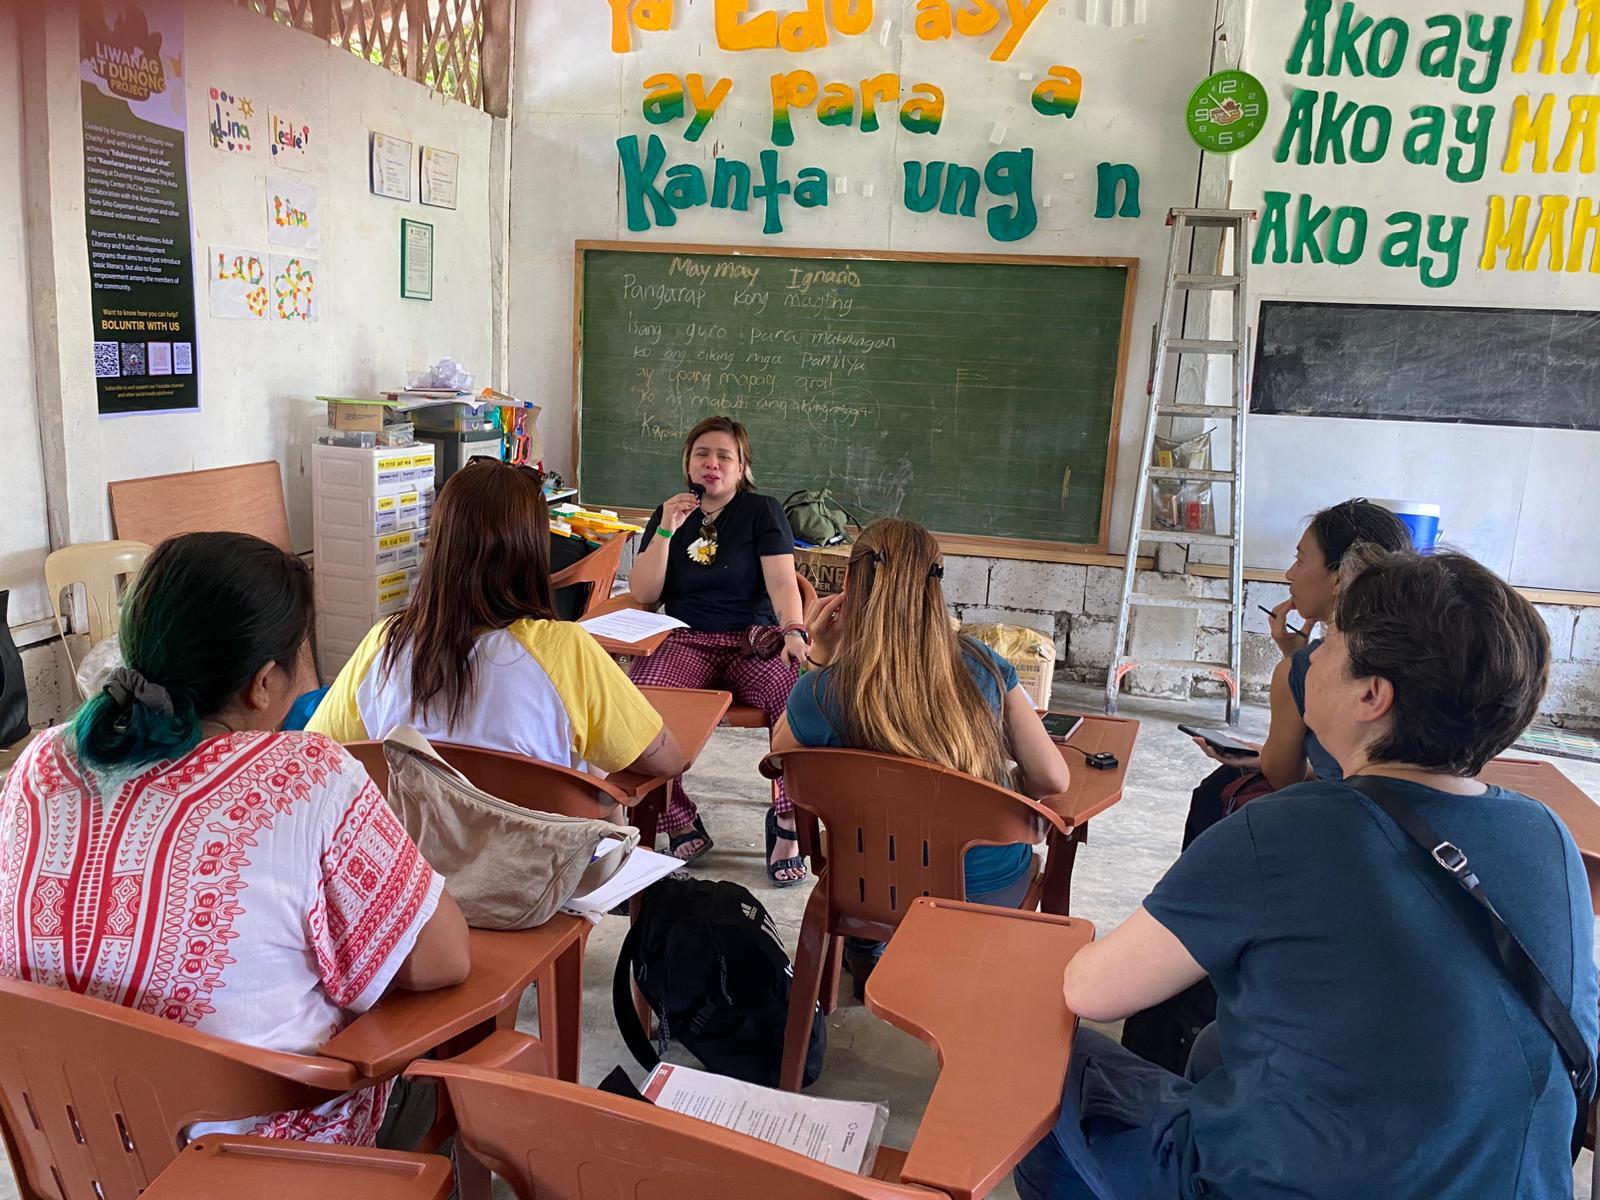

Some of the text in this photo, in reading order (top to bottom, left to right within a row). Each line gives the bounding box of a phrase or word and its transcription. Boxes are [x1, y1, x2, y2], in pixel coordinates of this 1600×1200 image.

[96, 41, 159, 75] LIWANAG
[1286, 0, 1409, 78] Ako
[1419, 14, 1512, 94] ay
[91, 56, 165, 91] AT DUNONG
[110, 79, 148, 98] PROJECT
[1219, 80, 1236, 94] 12
[642, 65, 1083, 147] ay para a
[1195, 109, 1209, 122] 9
[1244, 104, 1259, 117] 3
[1218, 131, 1233, 145] 6
[1274, 89, 1392, 166] Ako
[1403, 105, 1496, 183] ay
[616, 134, 1141, 242] Kanta ung n
[1251, 191, 1600, 288] Ako ay MAH
[102, 308, 116, 316] Want
[123, 309, 136, 317] know
[137, 309, 147, 317] how
[101, 320, 180, 332] BOLUNTIR WITH US
[686, 322, 728, 345] guro
